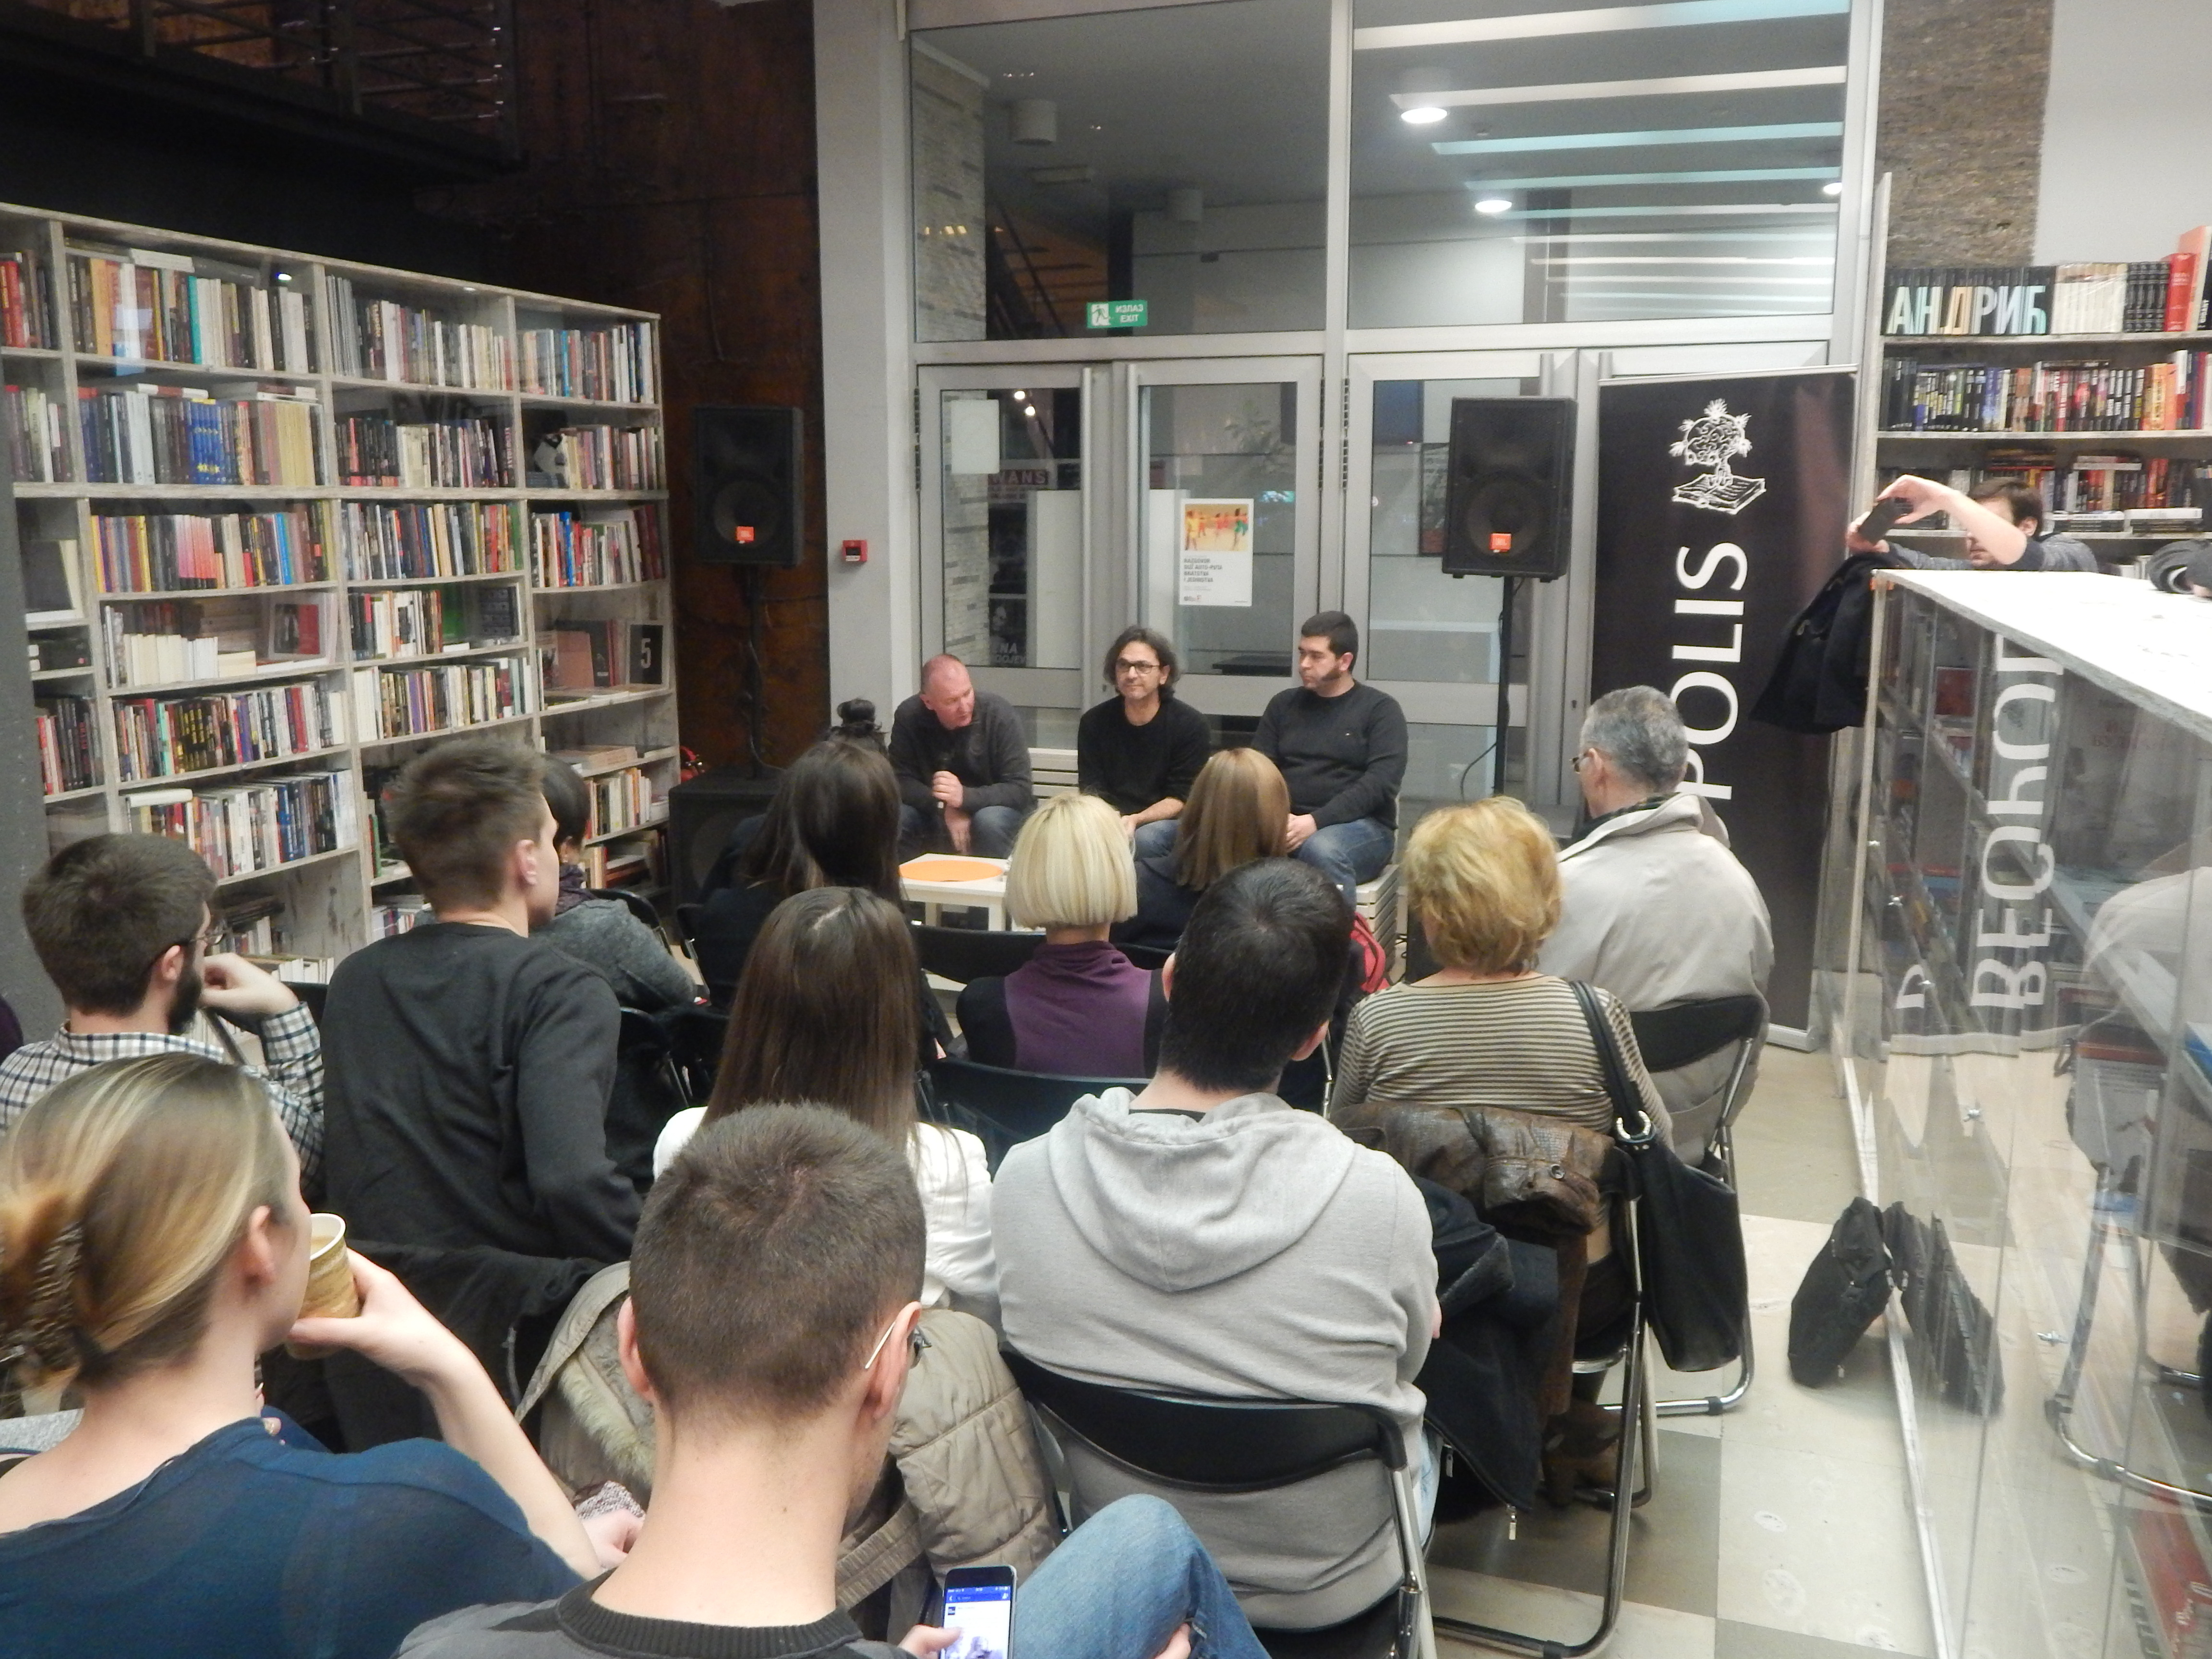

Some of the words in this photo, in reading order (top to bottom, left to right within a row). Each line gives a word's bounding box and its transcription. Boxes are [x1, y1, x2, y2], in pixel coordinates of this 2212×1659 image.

[1116, 304, 1143, 313] ИЗЛАЗ
[1120, 314, 1139, 323] EXIT
[641, 637, 651, 669] 5
